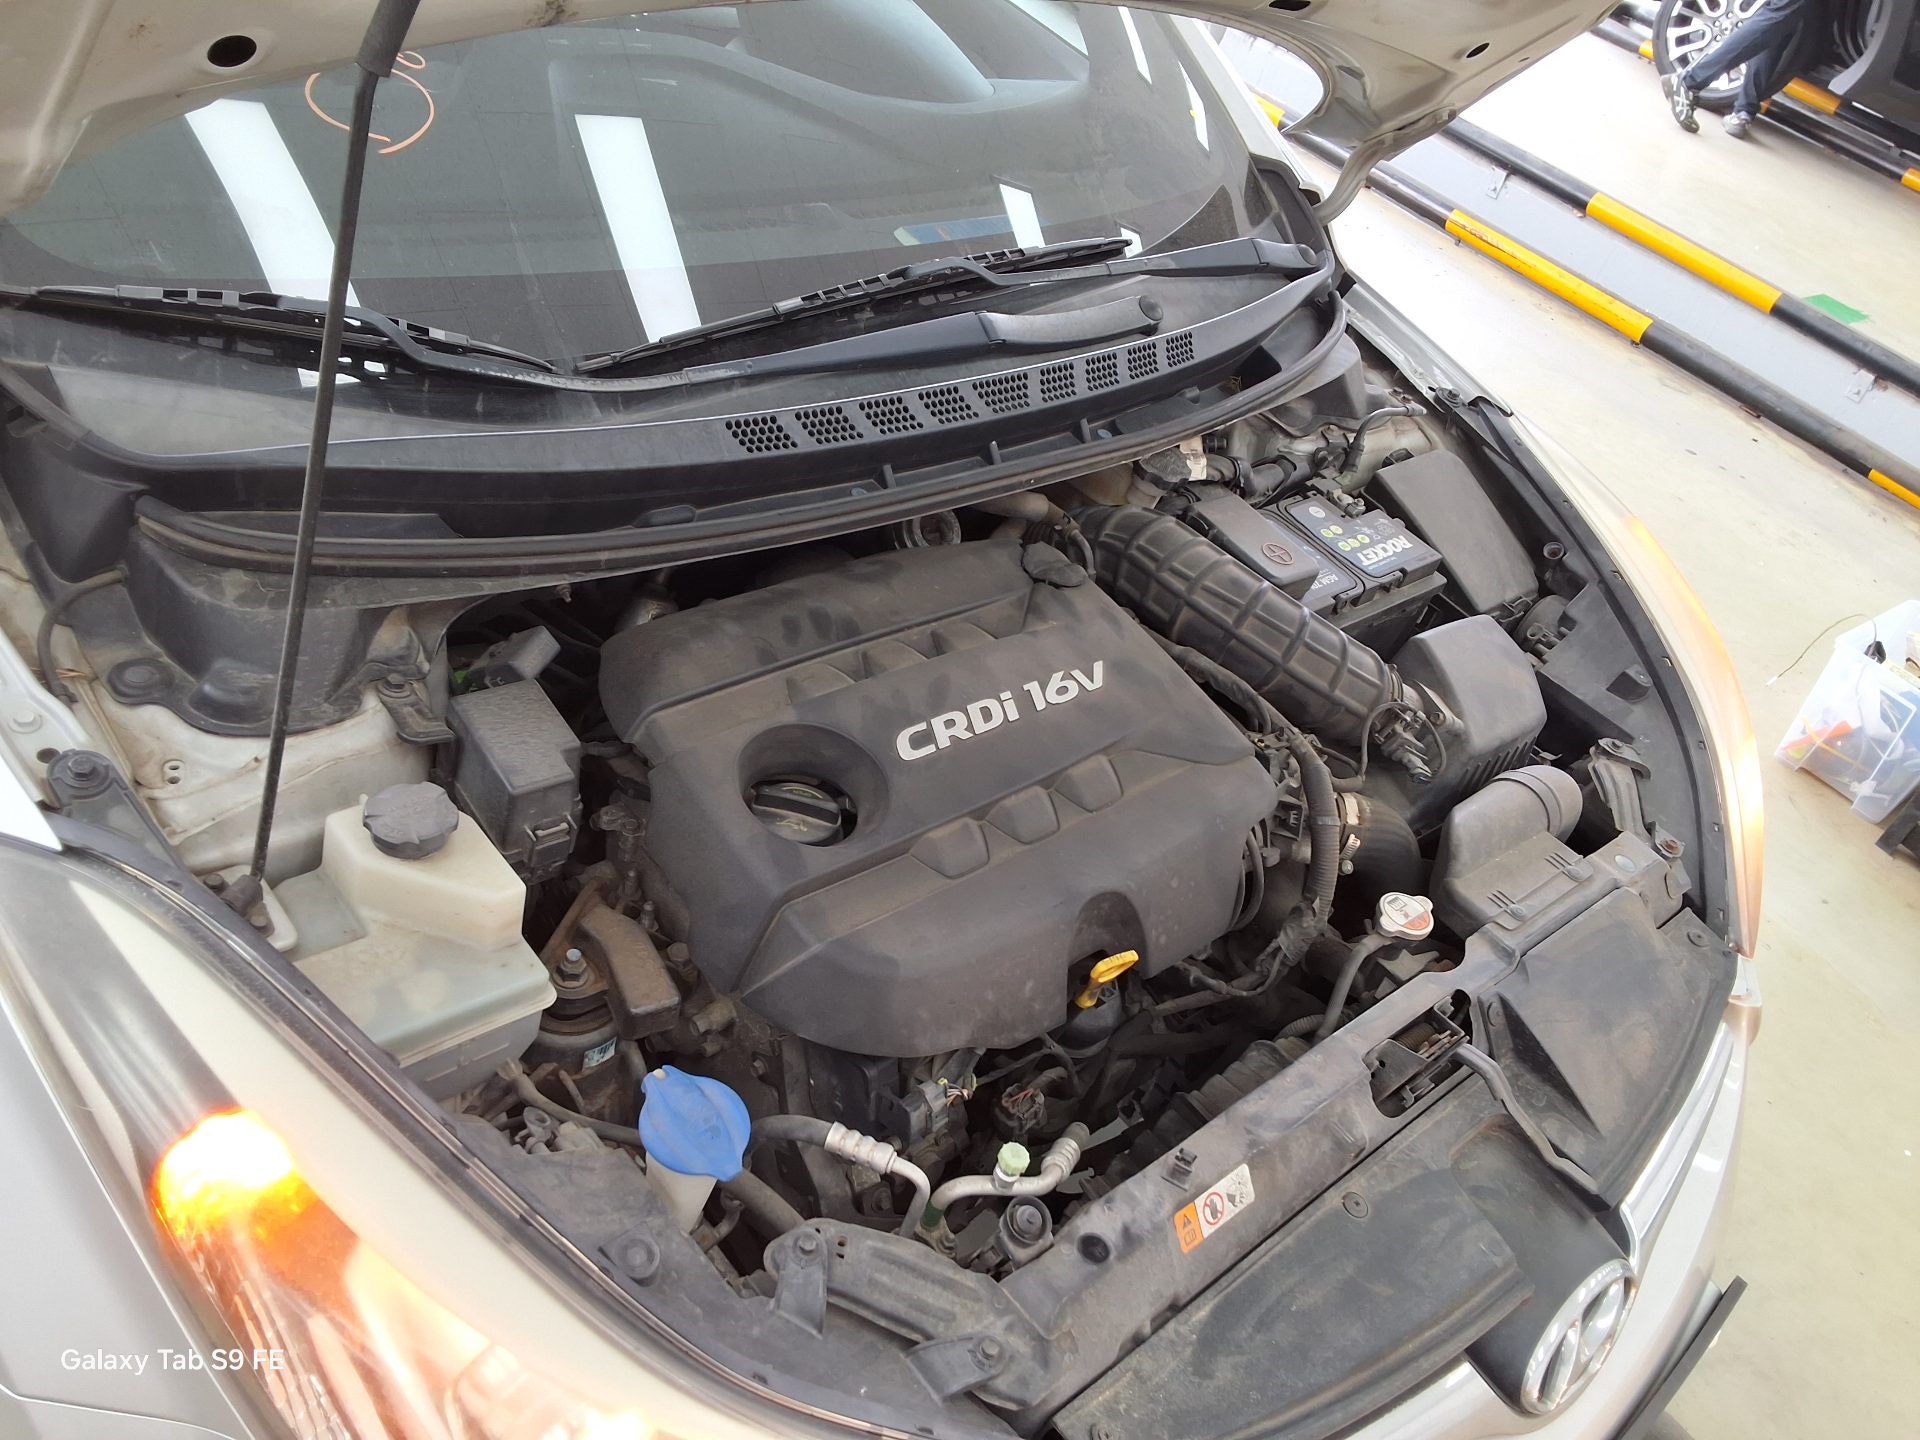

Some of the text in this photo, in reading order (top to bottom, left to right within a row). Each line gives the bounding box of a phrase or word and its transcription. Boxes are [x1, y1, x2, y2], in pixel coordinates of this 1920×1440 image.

[1357, 535, 1413, 565] ROCKET
[1320, 574, 1339, 585] AGM
[896, 660, 1104, 761] CRDi 16V
